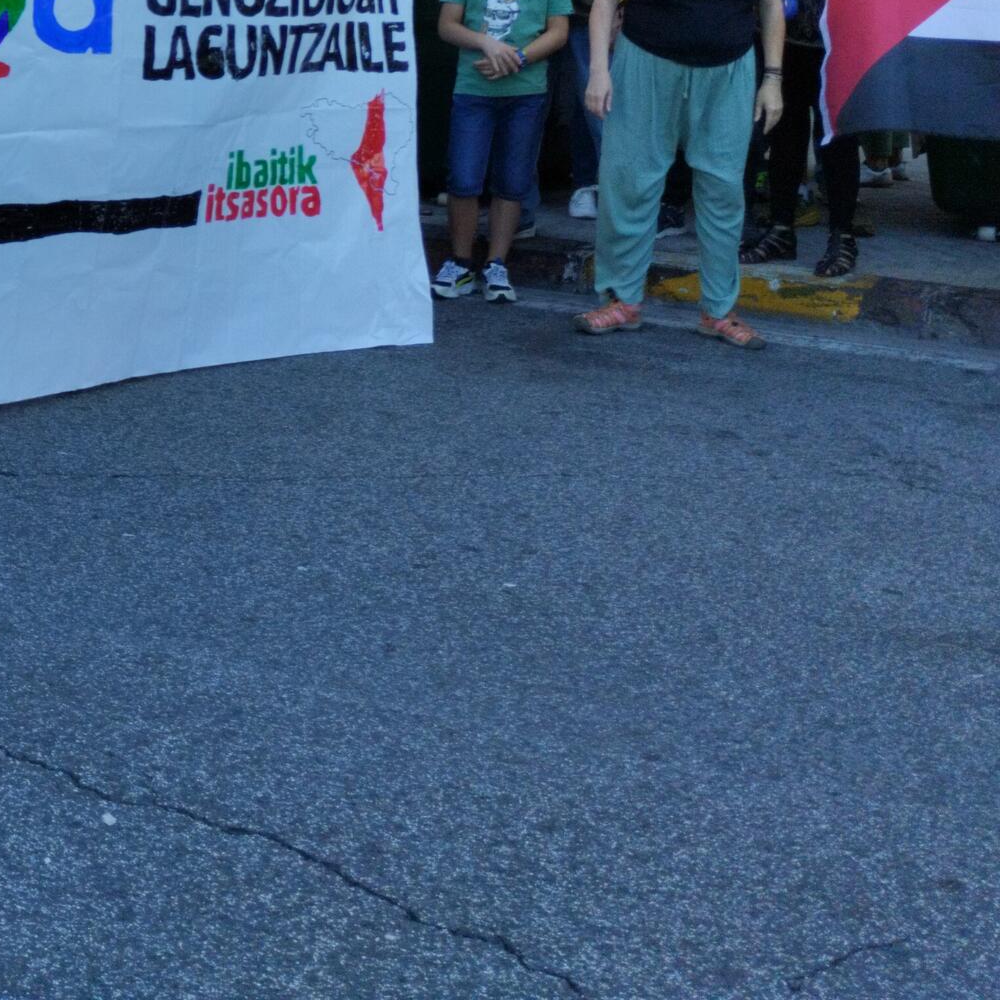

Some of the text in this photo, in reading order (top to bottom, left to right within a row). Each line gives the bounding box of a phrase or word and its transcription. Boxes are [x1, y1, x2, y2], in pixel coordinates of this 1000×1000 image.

[142, 21, 409, 81] LAGUNTZAILE
[226, 144, 318, 191] ibaitik
[204, 183, 321, 223] itsasora
